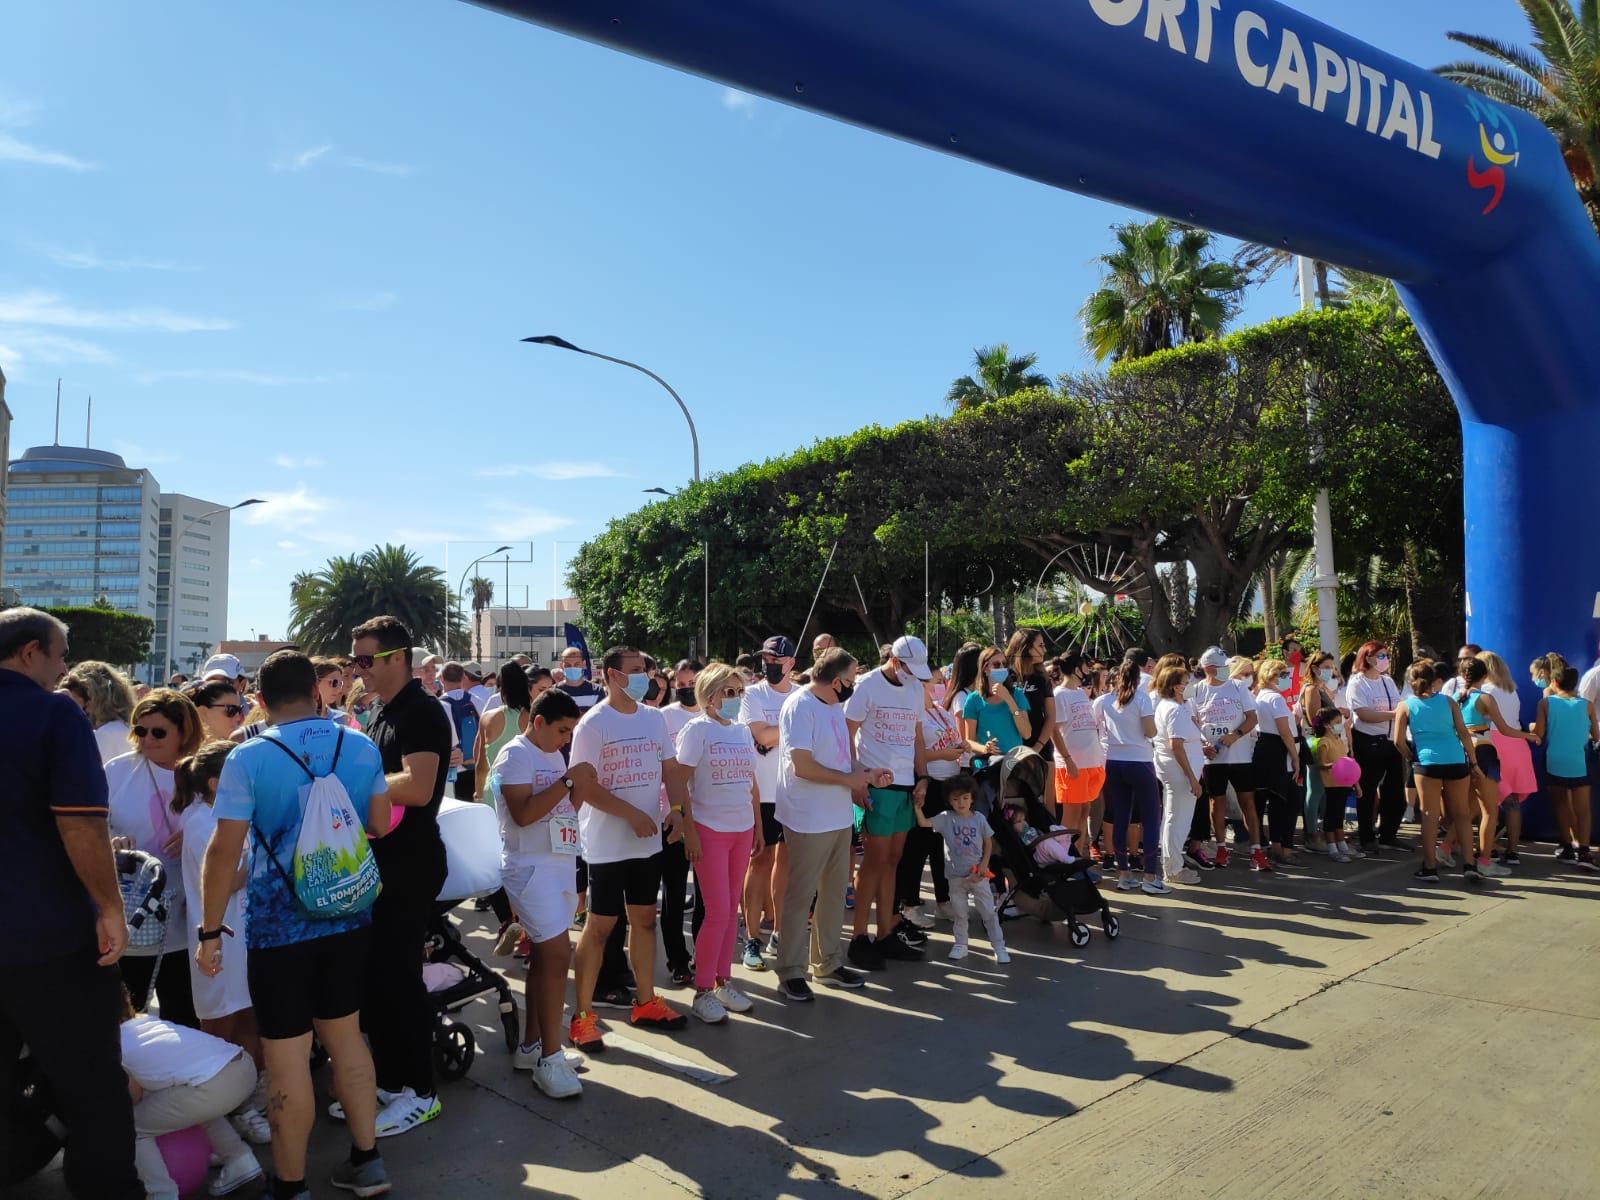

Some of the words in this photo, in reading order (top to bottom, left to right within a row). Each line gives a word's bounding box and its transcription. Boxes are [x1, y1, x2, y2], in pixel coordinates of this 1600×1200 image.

[1234, 10, 1441, 160] CAPITAL
[876, 710, 890, 719] En
[1211, 727, 1229, 736] 790
[603, 745, 618, 759] En
[622, 740, 657, 755] march
[710, 745, 726, 755] En
[603, 757, 642, 772] contra
[710, 757, 751, 768] contra
[711, 768, 724, 780] el
[727, 767, 753, 779] cánce
[535, 774, 552, 786] En
[601, 774, 614, 787] el
[560, 827, 577, 844] 175
[316, 897, 329, 908] EL
